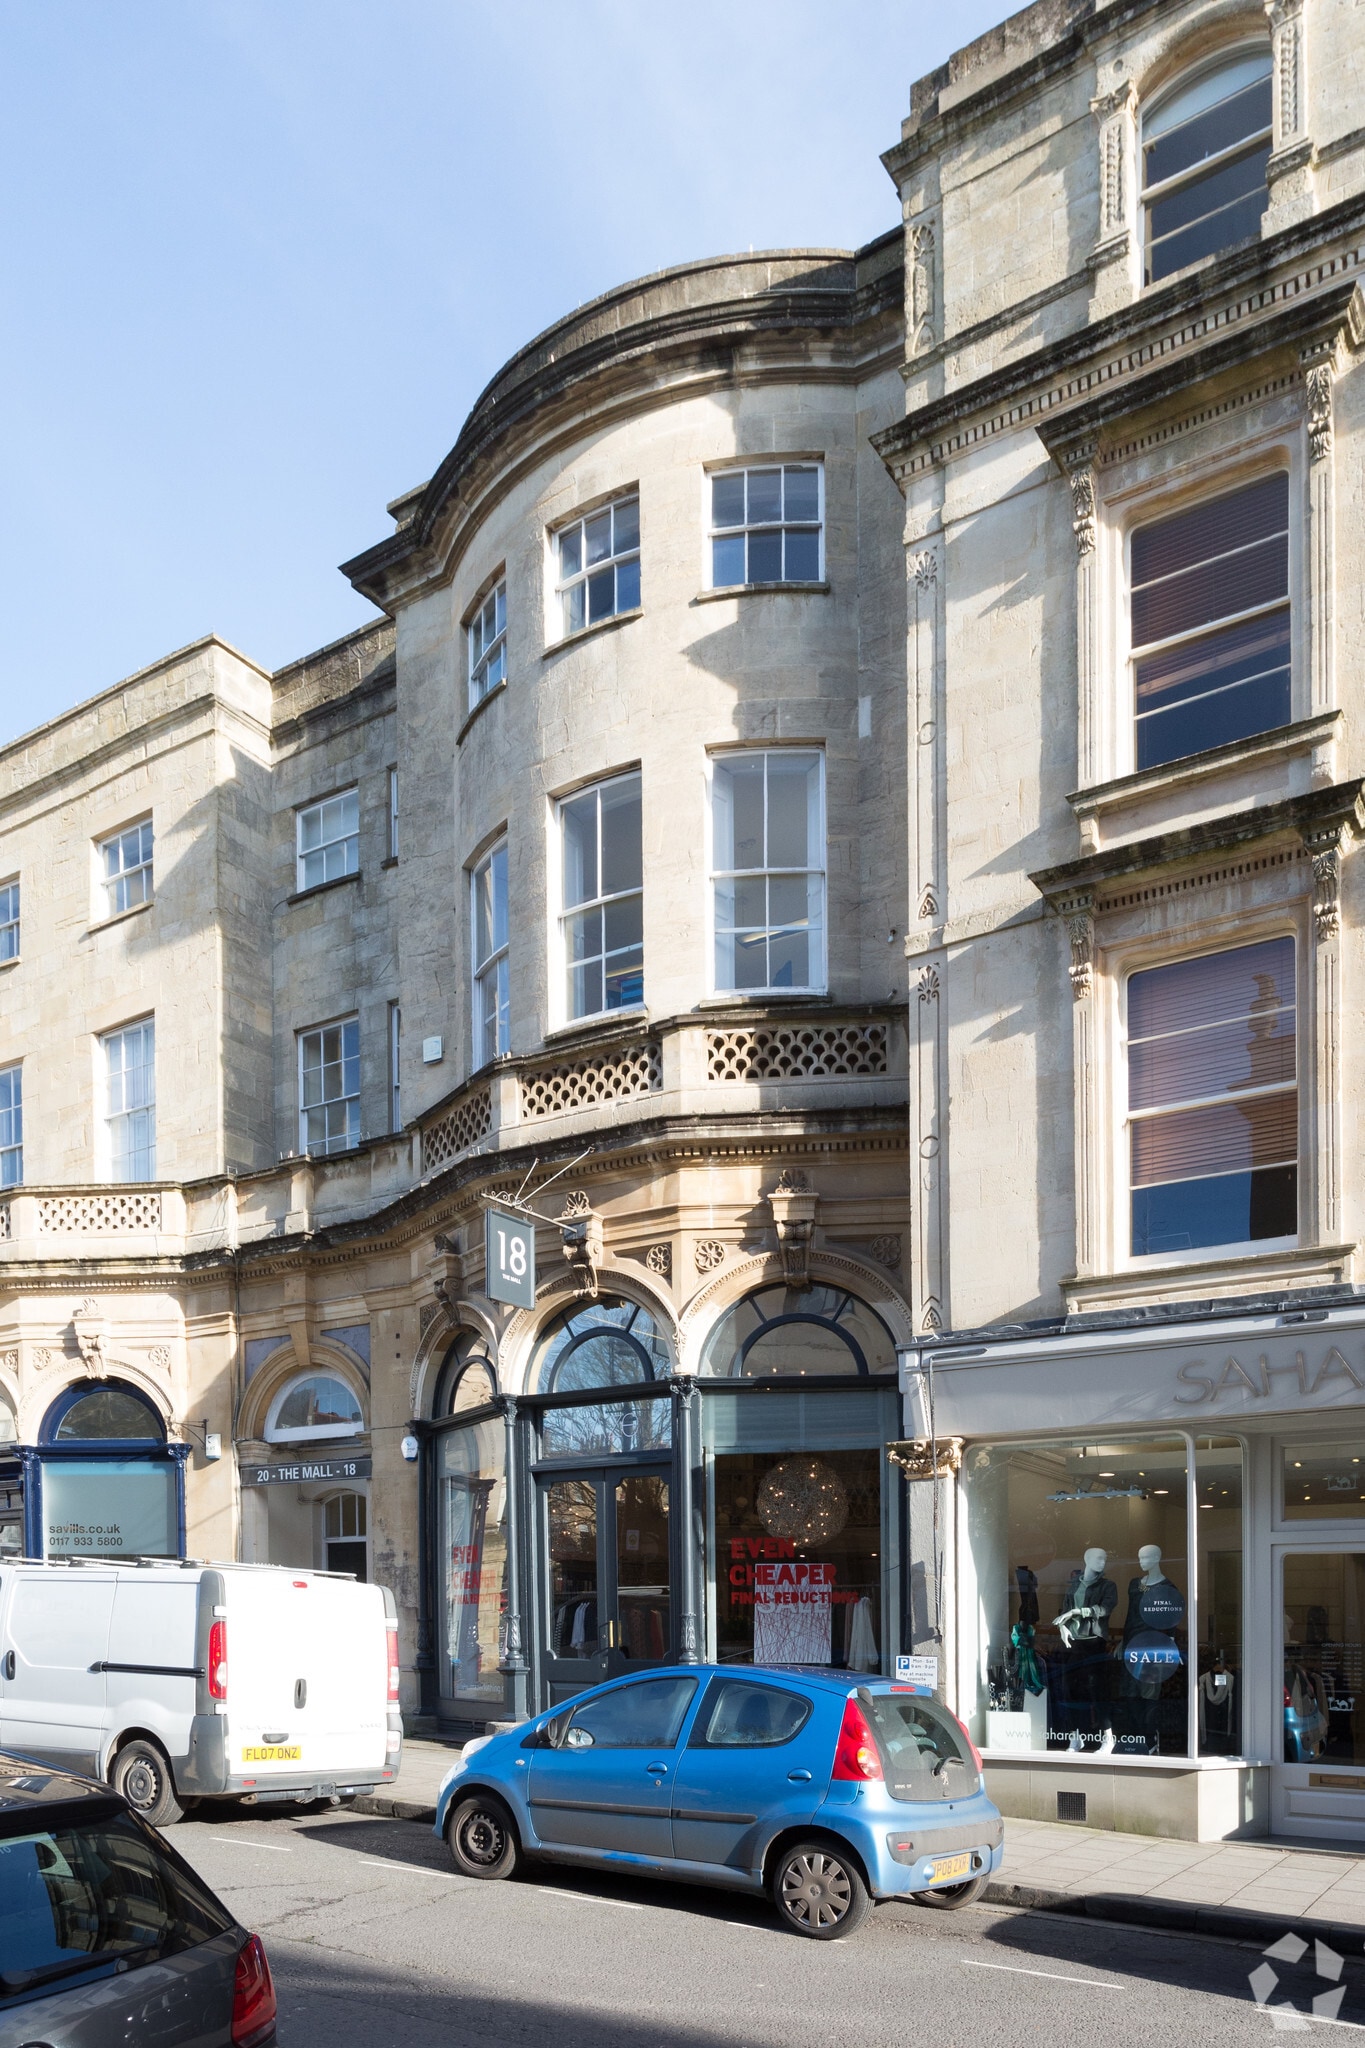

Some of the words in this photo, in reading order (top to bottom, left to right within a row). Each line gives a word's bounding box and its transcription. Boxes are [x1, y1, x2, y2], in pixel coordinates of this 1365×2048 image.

[497, 1230, 527, 1276] 18
[257, 1470, 269, 1482] 20
[278, 1467, 299, 1480] THE
[302, 1465, 333, 1479] MALL
[343, 1463, 356, 1476] 18
[49, 1523, 120, 1534] savills.co.uk
[49, 1537, 69, 1546] 0117
[74, 1537, 93, 1546] 933
[97, 1537, 123, 1546] 5800
[731, 1537, 795, 1559] EVEN
[453, 1545, 478, 1564] EVEN
[729, 1564, 837, 1585] CHEAPER
[731, 1592, 769, 1605] FINAL
[774, 1591, 859, 1605] REDUCTIONS
[900, 1658, 909, 1669] P
[1129, 1651, 1174, 1663] SALE
[1005, 1727, 1146, 1744] wwwsaharalondon.com
[246, 1748, 275, 1760] FL07
